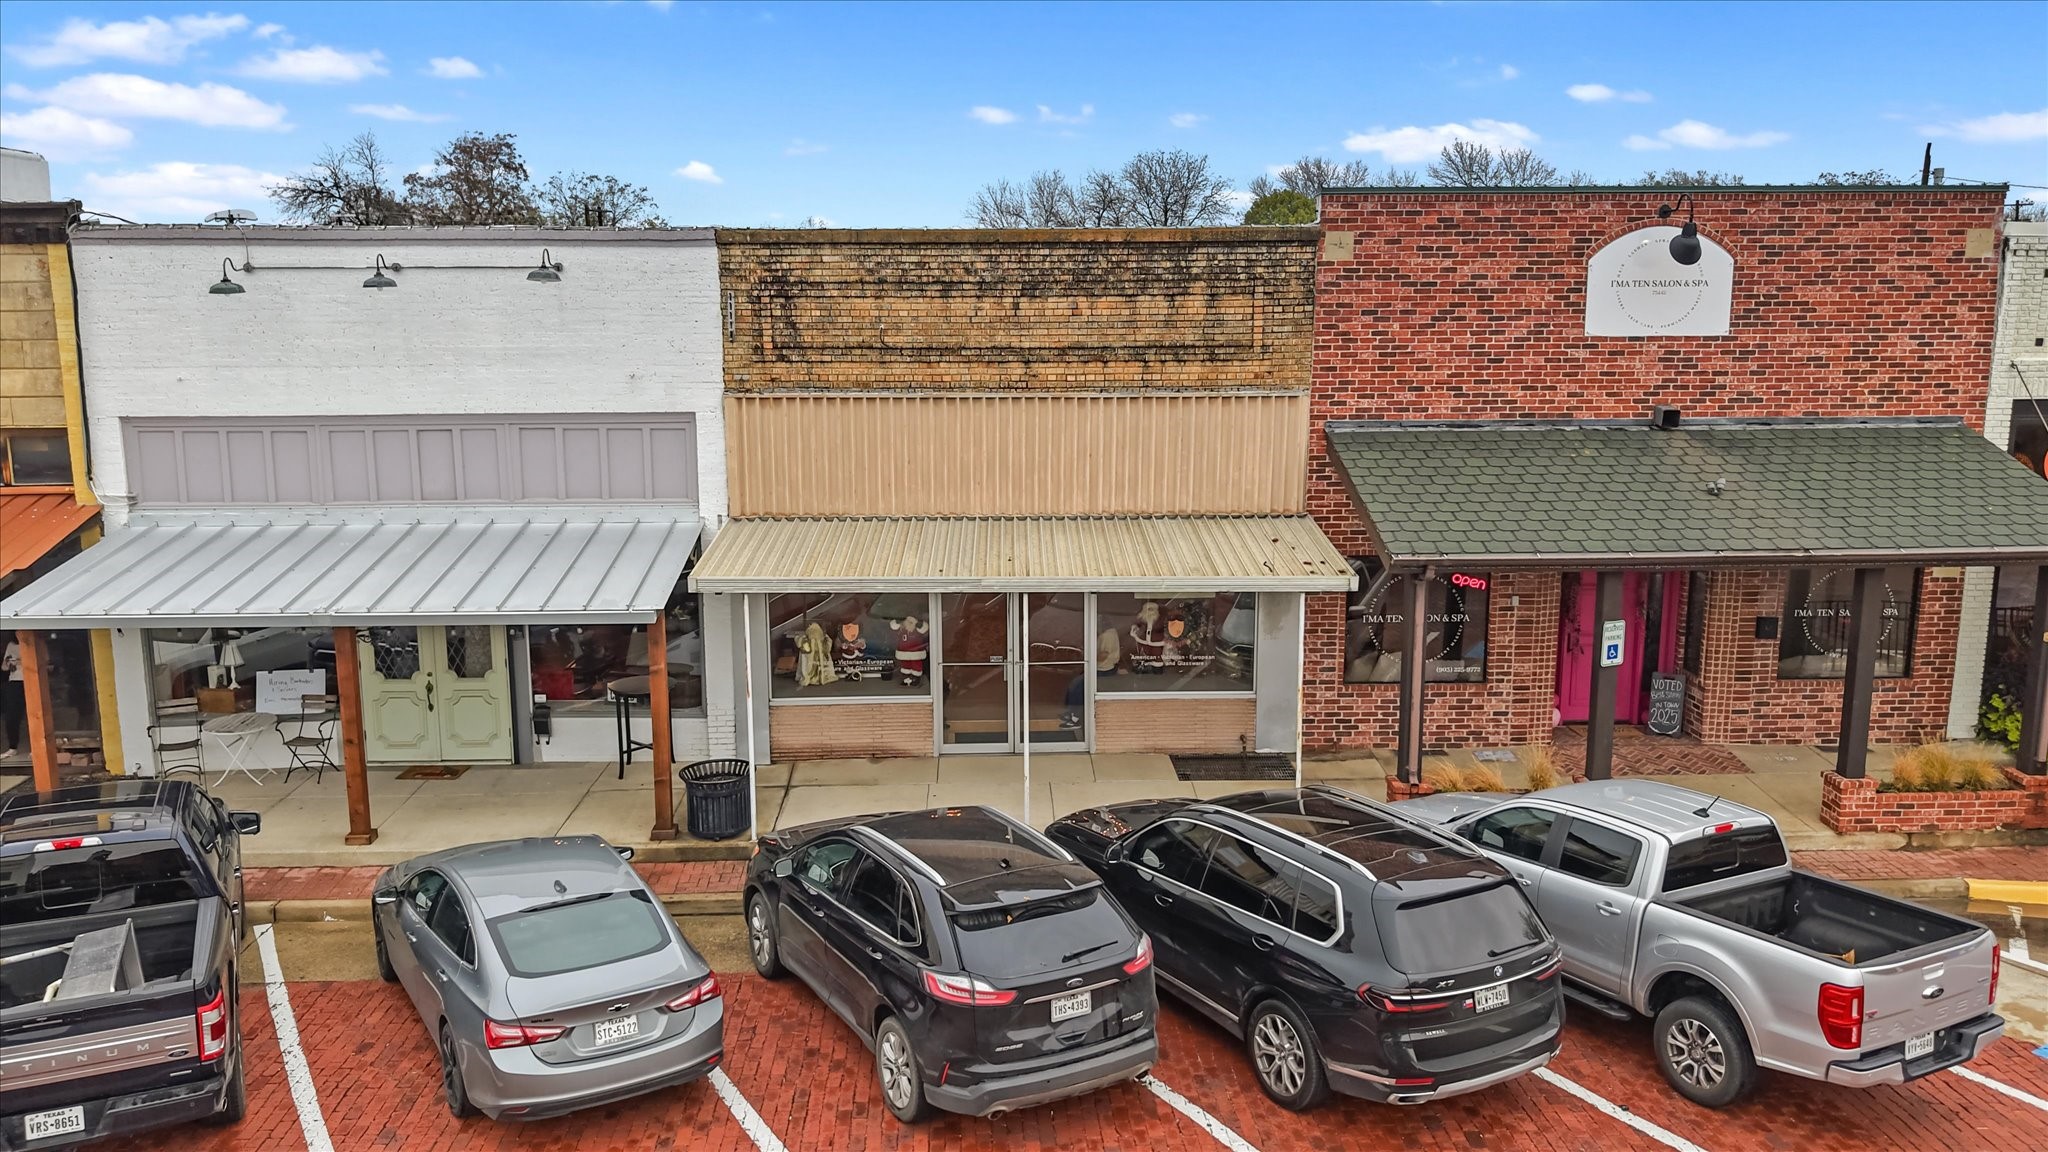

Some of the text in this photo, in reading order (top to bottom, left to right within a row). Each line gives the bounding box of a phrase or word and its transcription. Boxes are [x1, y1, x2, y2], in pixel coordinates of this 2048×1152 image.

[1632, 280, 1650, 288] TEN
[1652, 279, 1682, 288] SALON
[1691, 279, 1709, 287] SPA
[1817, 609, 1835, 617] TEN
[1883, 608, 1899, 616] SPA
[1386, 614, 1404, 623] TEN
[1442, 614, 1449, 622] &
[1451, 613, 1471, 622] SPA
[1653, 679, 1682, 691] VOTED
[1651, 708, 1678, 724] 2025
[1436, 979, 1455, 989] X7
[608, 1018, 625, 1026] TEXAS
[43, 1111, 66, 1119] TEXAS
